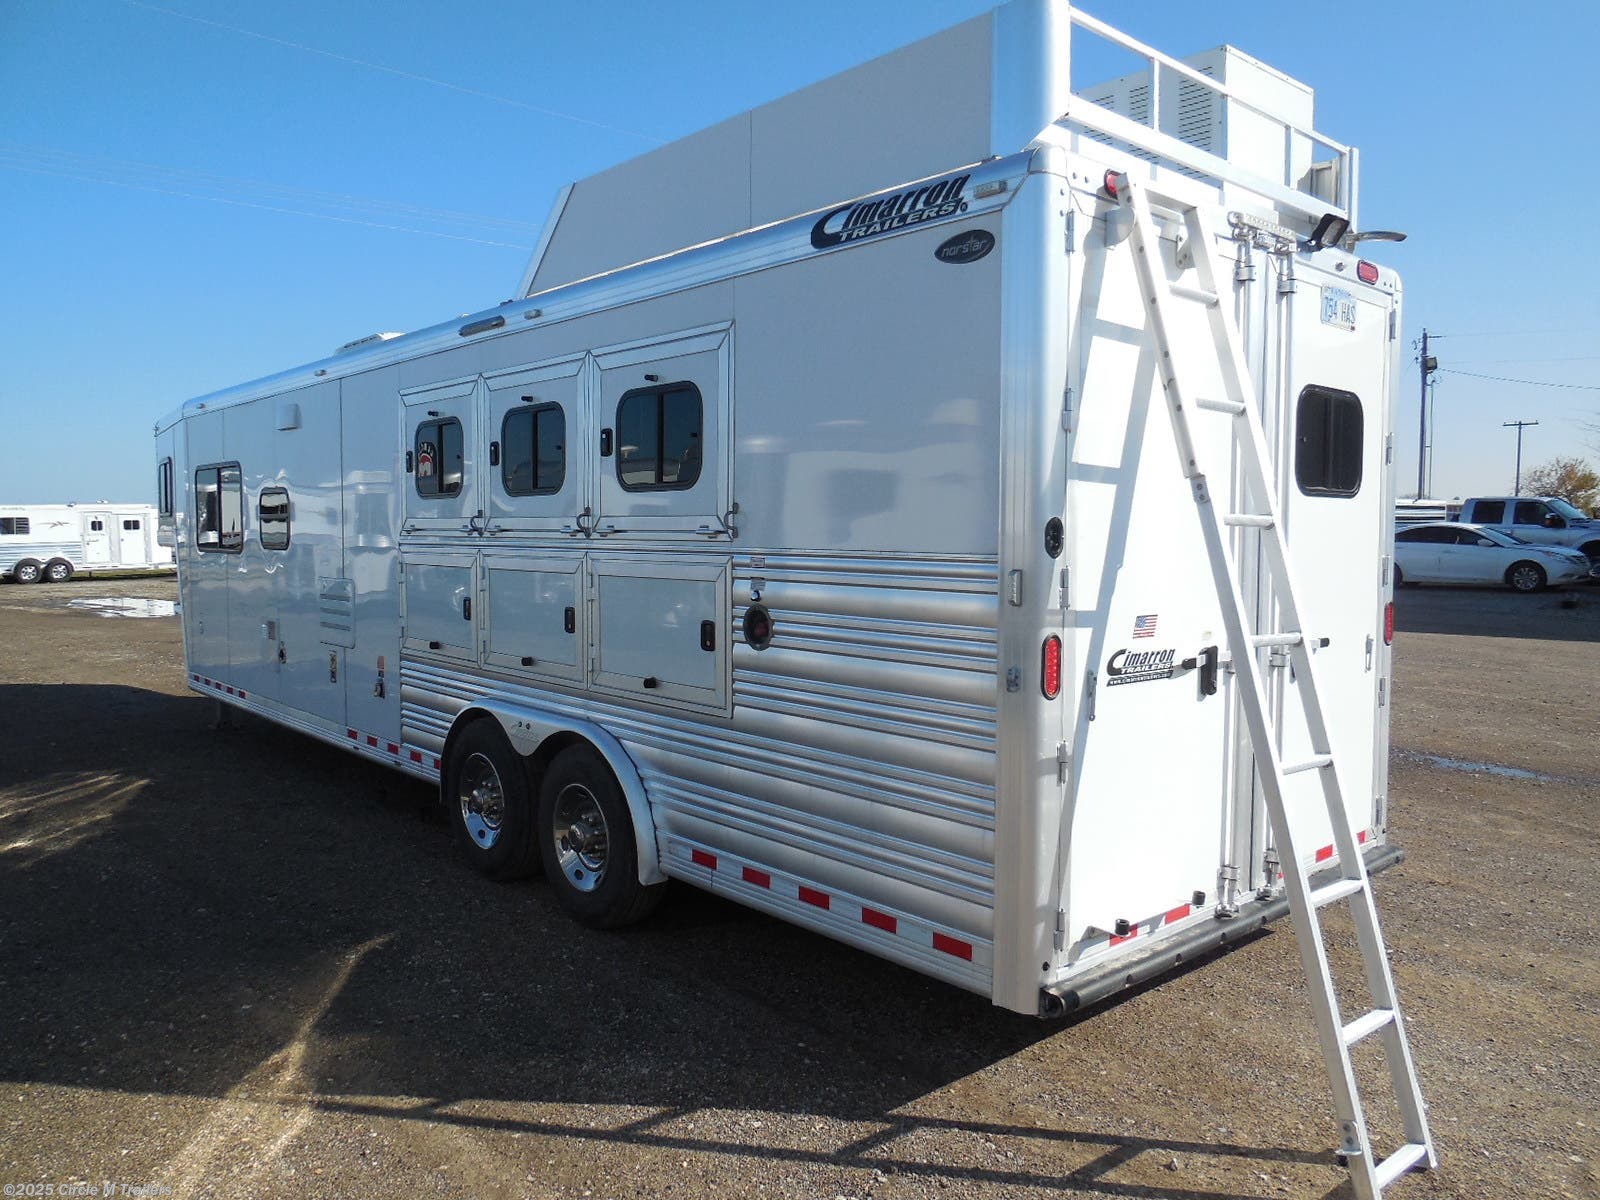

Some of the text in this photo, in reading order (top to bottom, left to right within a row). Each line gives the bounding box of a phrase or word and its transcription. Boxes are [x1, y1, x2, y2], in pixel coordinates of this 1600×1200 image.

[811, 174, 971, 249] Cimarron
[839, 199, 958, 242] TRAILERS
[1106, 649, 1176, 676] Cimarron
[1120, 662, 1172, 675] TRAILERS
